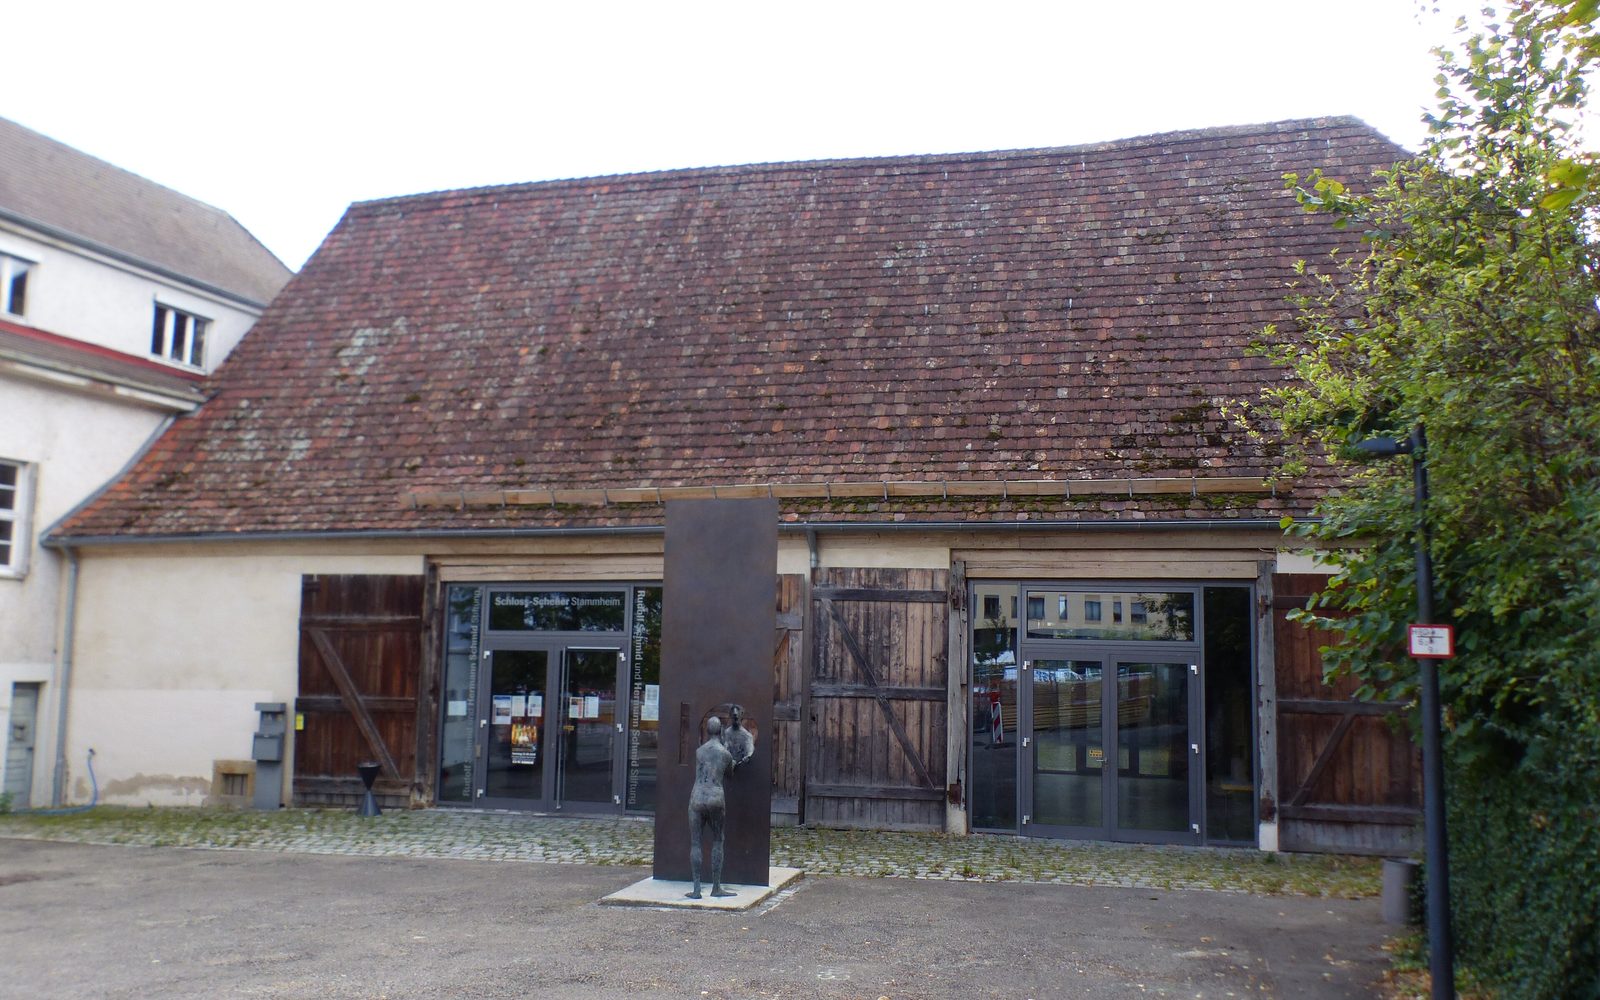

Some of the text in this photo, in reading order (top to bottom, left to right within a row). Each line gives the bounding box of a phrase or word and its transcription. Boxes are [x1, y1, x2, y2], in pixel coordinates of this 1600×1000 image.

[471, 590, 481, 623] Stiftung
[571, 596, 620, 606] Stammheim
[469, 625, 479, 661] Schmid
[467, 662, 477, 706] Hermann
[628, 590, 646, 805] Rudolf Schmid und Hermann Schmid Stiftung
[462, 765, 472, 797] Rudolf
